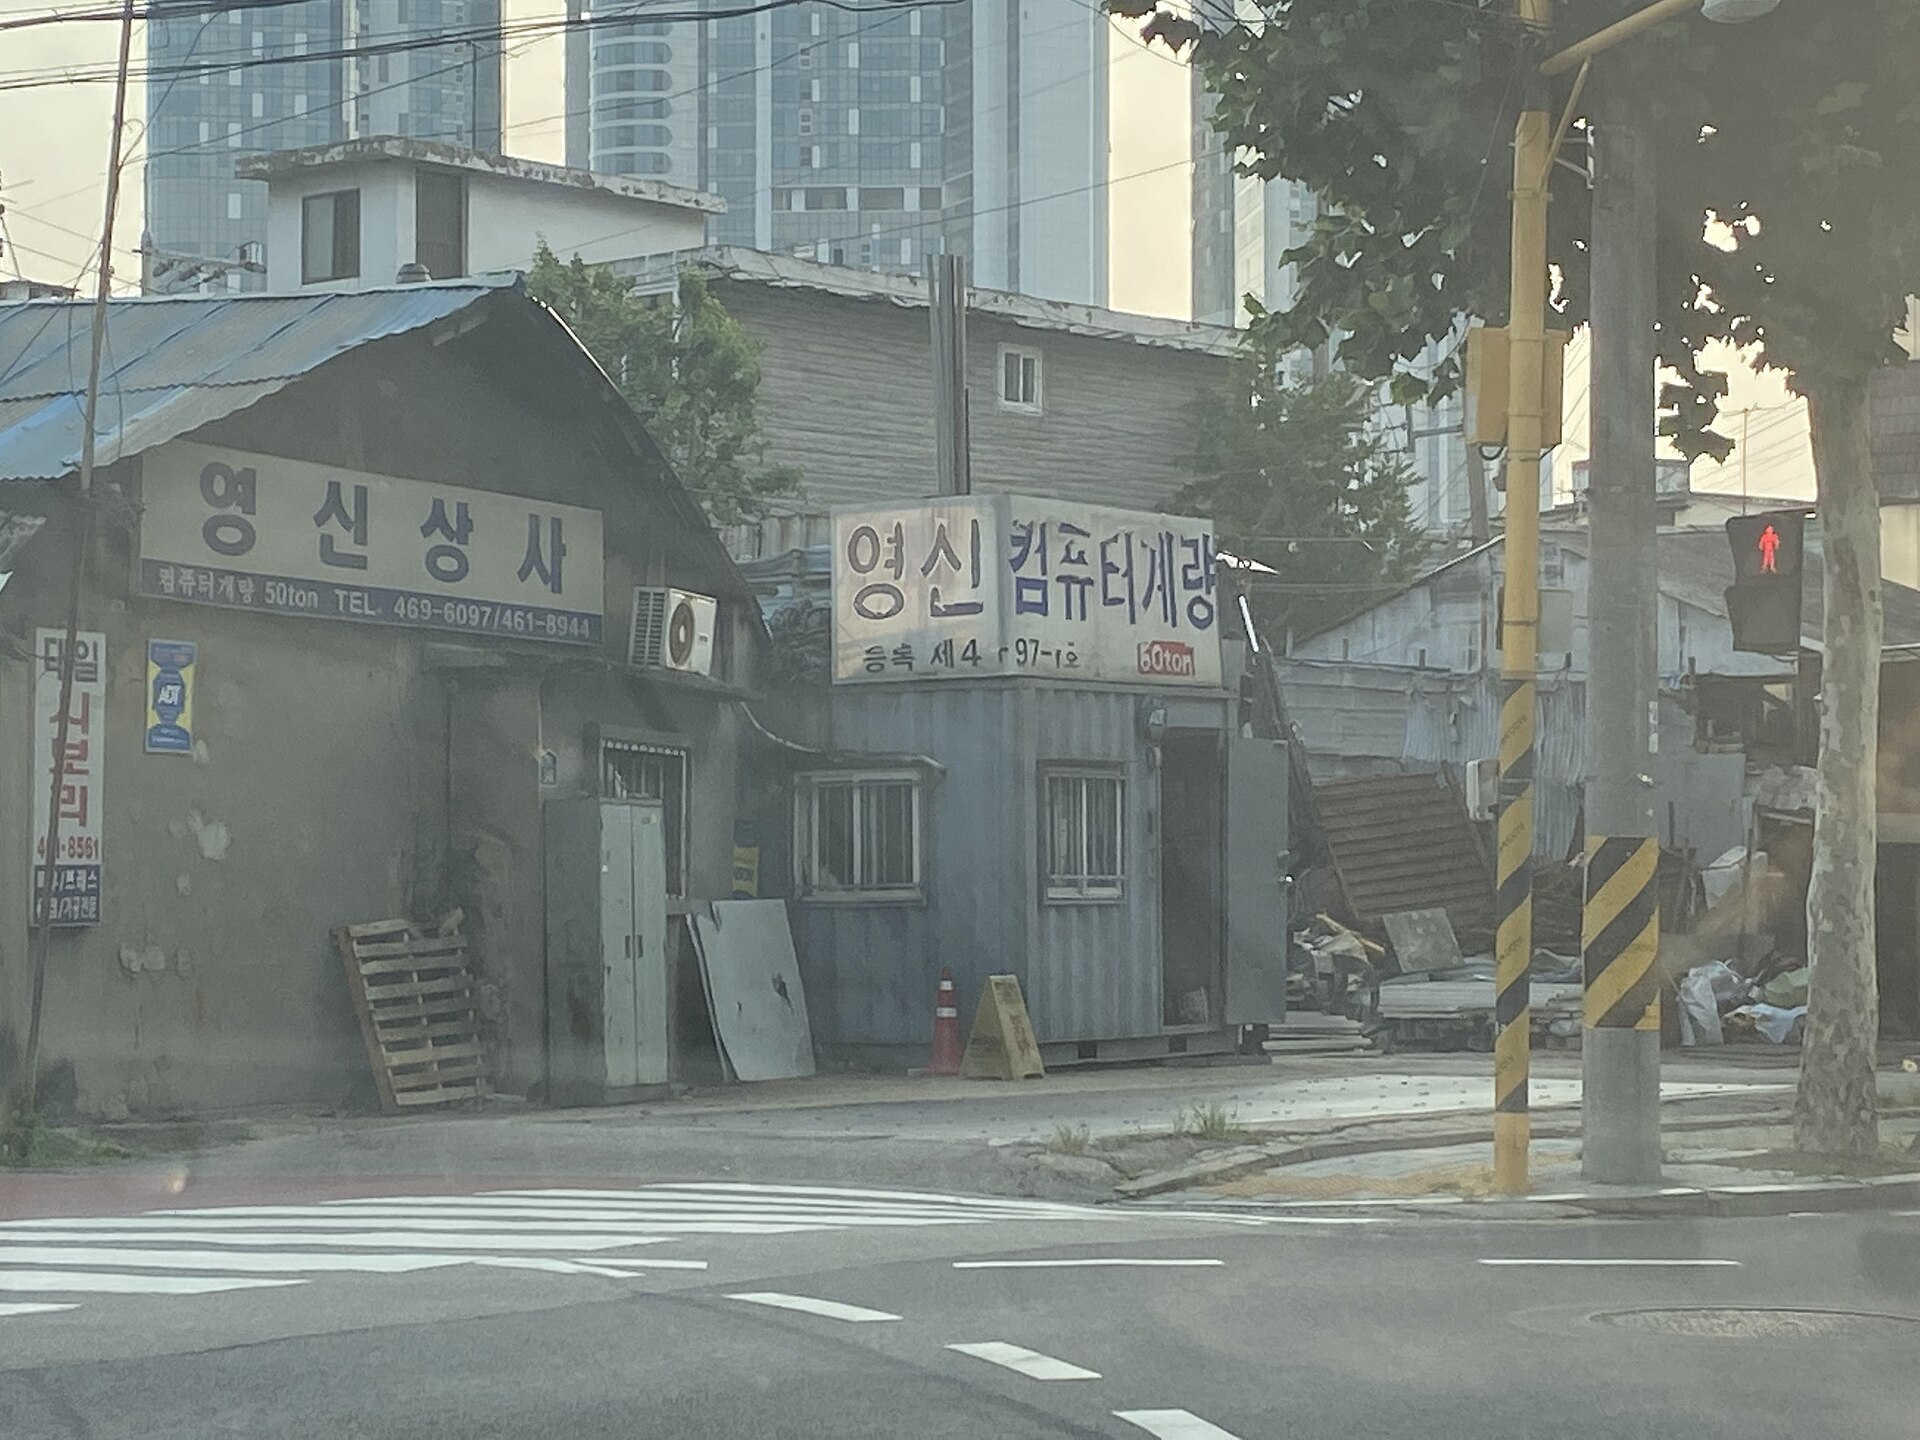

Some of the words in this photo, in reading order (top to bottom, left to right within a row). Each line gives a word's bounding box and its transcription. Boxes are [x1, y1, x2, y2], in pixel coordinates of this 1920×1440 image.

[201, 461, 566, 594] 영신상사
[847, 519, 984, 619] 영신
[1008, 519, 1216, 630] 컴퓨터계량
[265, 581, 318, 608] 50ton
[394, 596, 590, 638] 469-6097/461-8944
